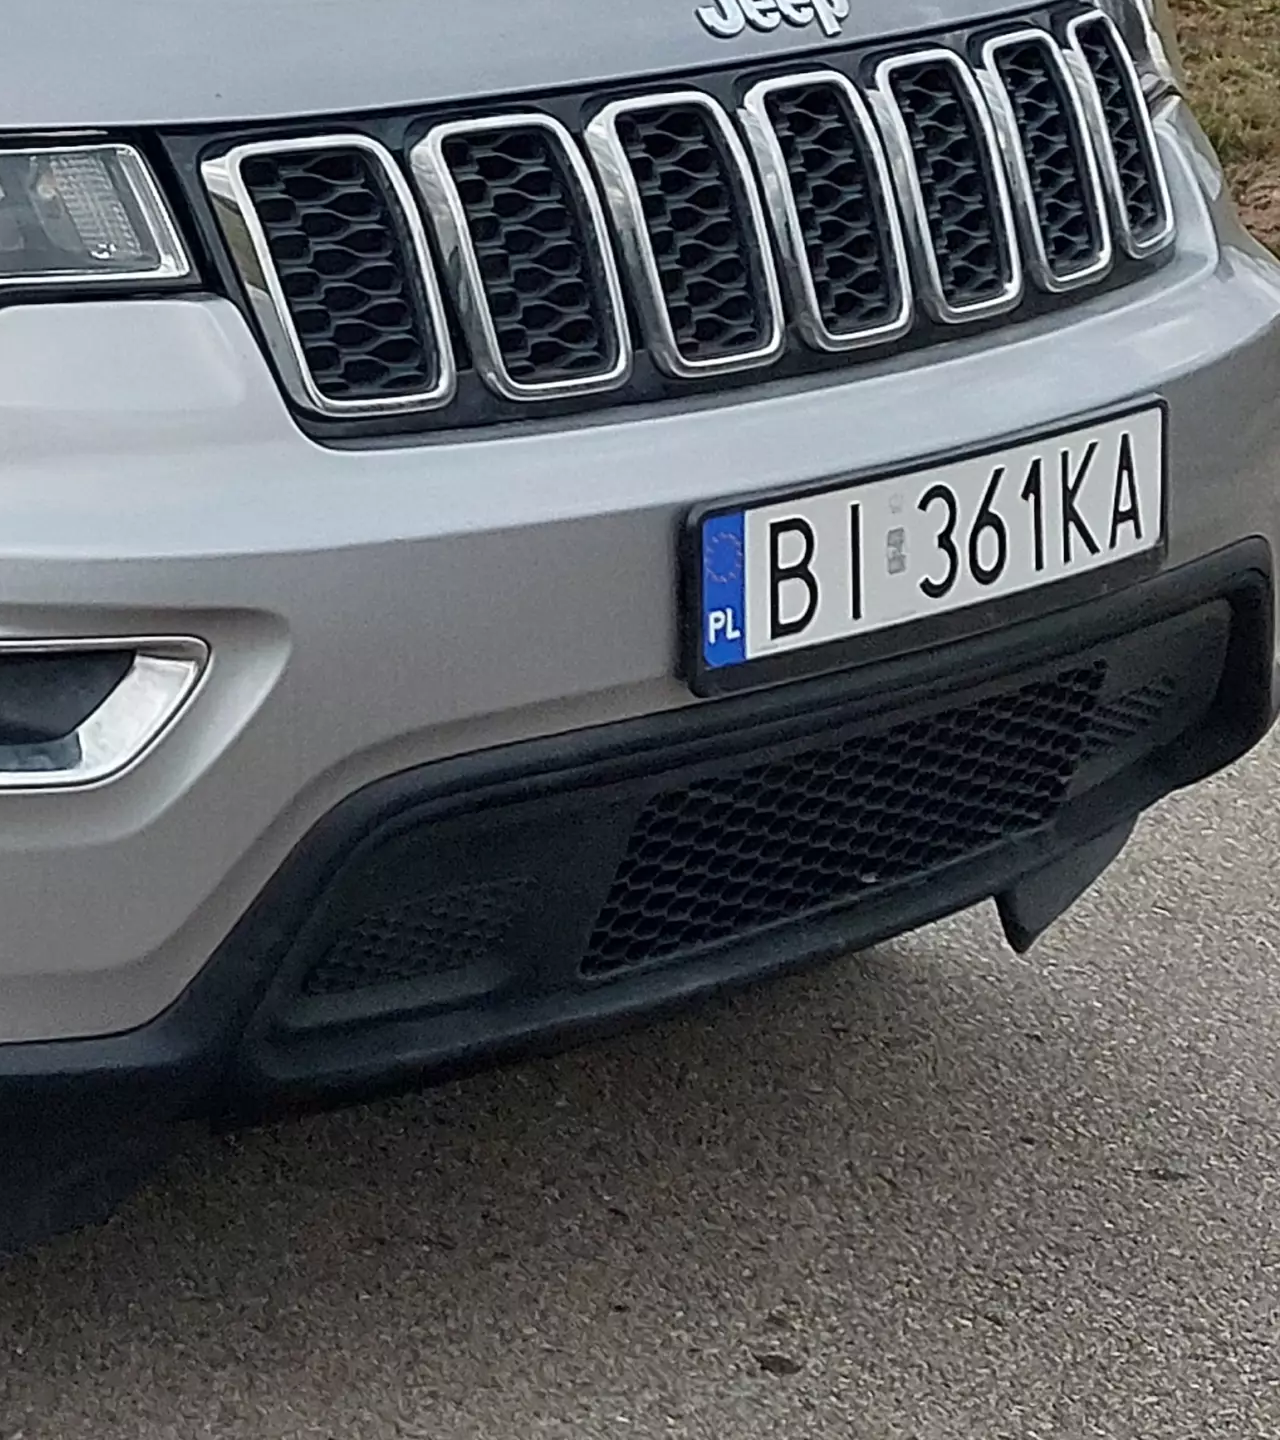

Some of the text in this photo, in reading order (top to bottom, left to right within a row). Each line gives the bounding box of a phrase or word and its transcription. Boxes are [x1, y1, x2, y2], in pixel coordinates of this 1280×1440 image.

[769, 432, 1143, 641] BI 361KA
[708, 608, 741, 644] PL
